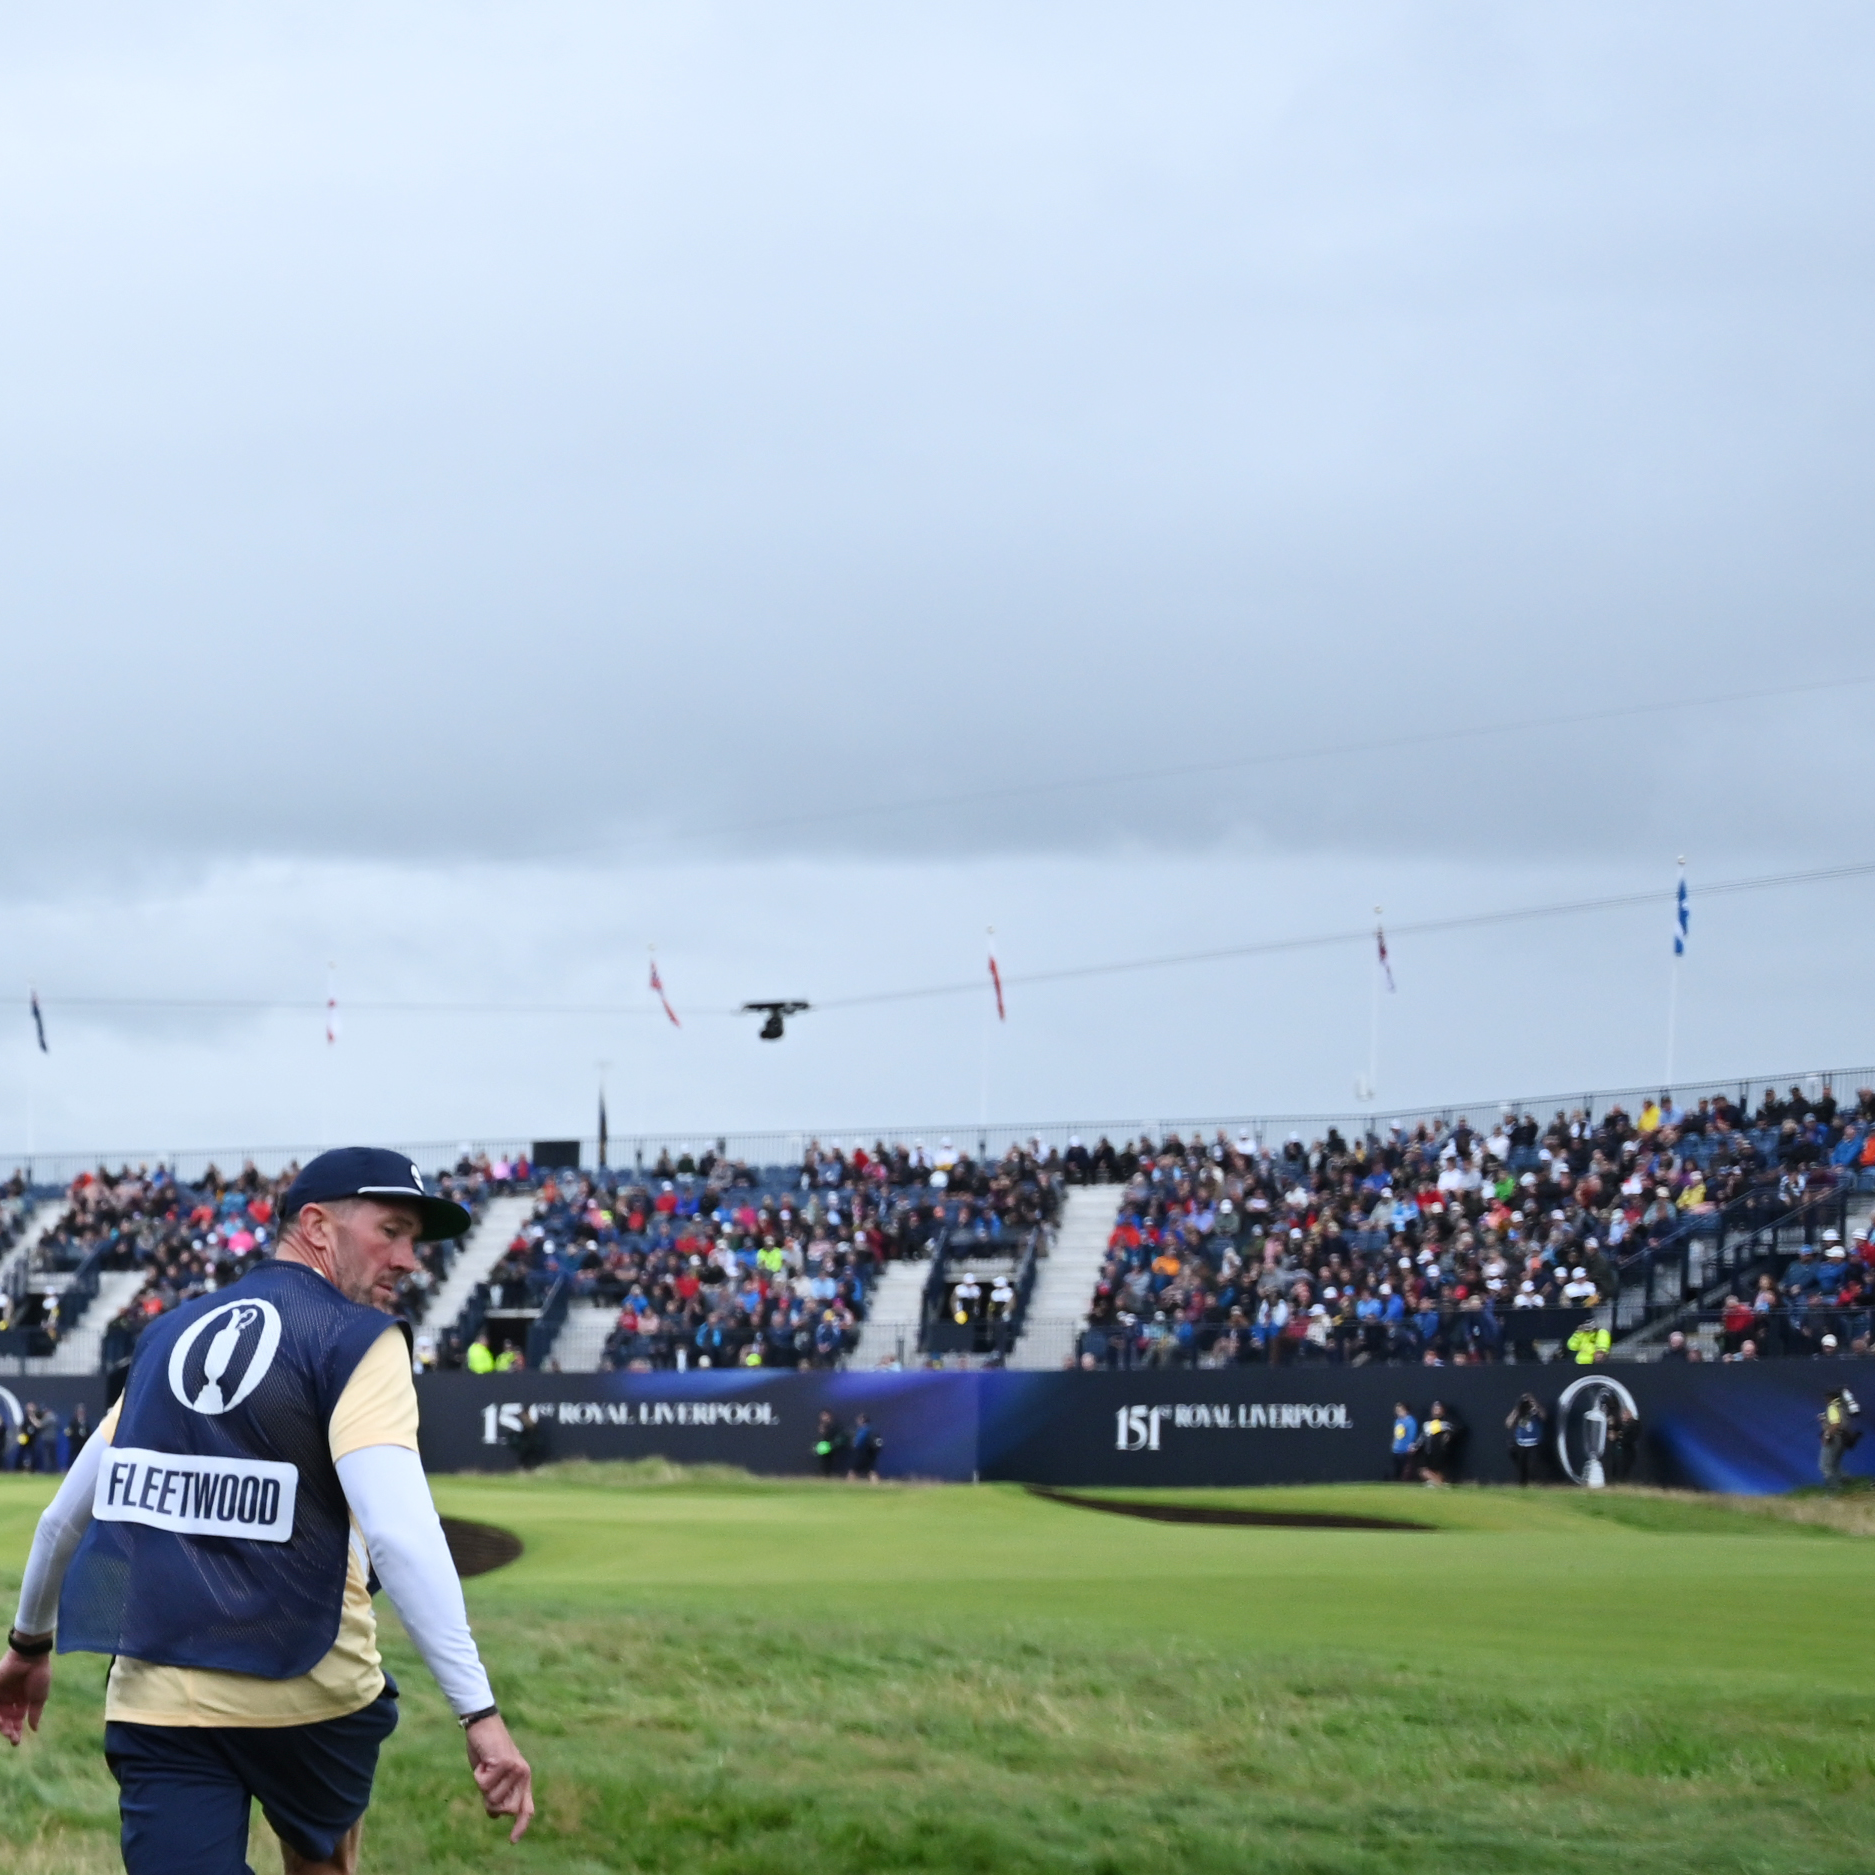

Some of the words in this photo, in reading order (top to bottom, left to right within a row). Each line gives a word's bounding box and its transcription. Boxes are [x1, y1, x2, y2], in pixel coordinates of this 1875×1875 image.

[559, 1402, 635, 1425] ROYAL
[639, 1402, 780, 1426] LIVERPOOL
[1175, 1403, 1236, 1428] ROYAL
[1238, 1403, 1353, 1429] LIVERPOOL
[107, 1461, 281, 1526] FLEETWOOD
